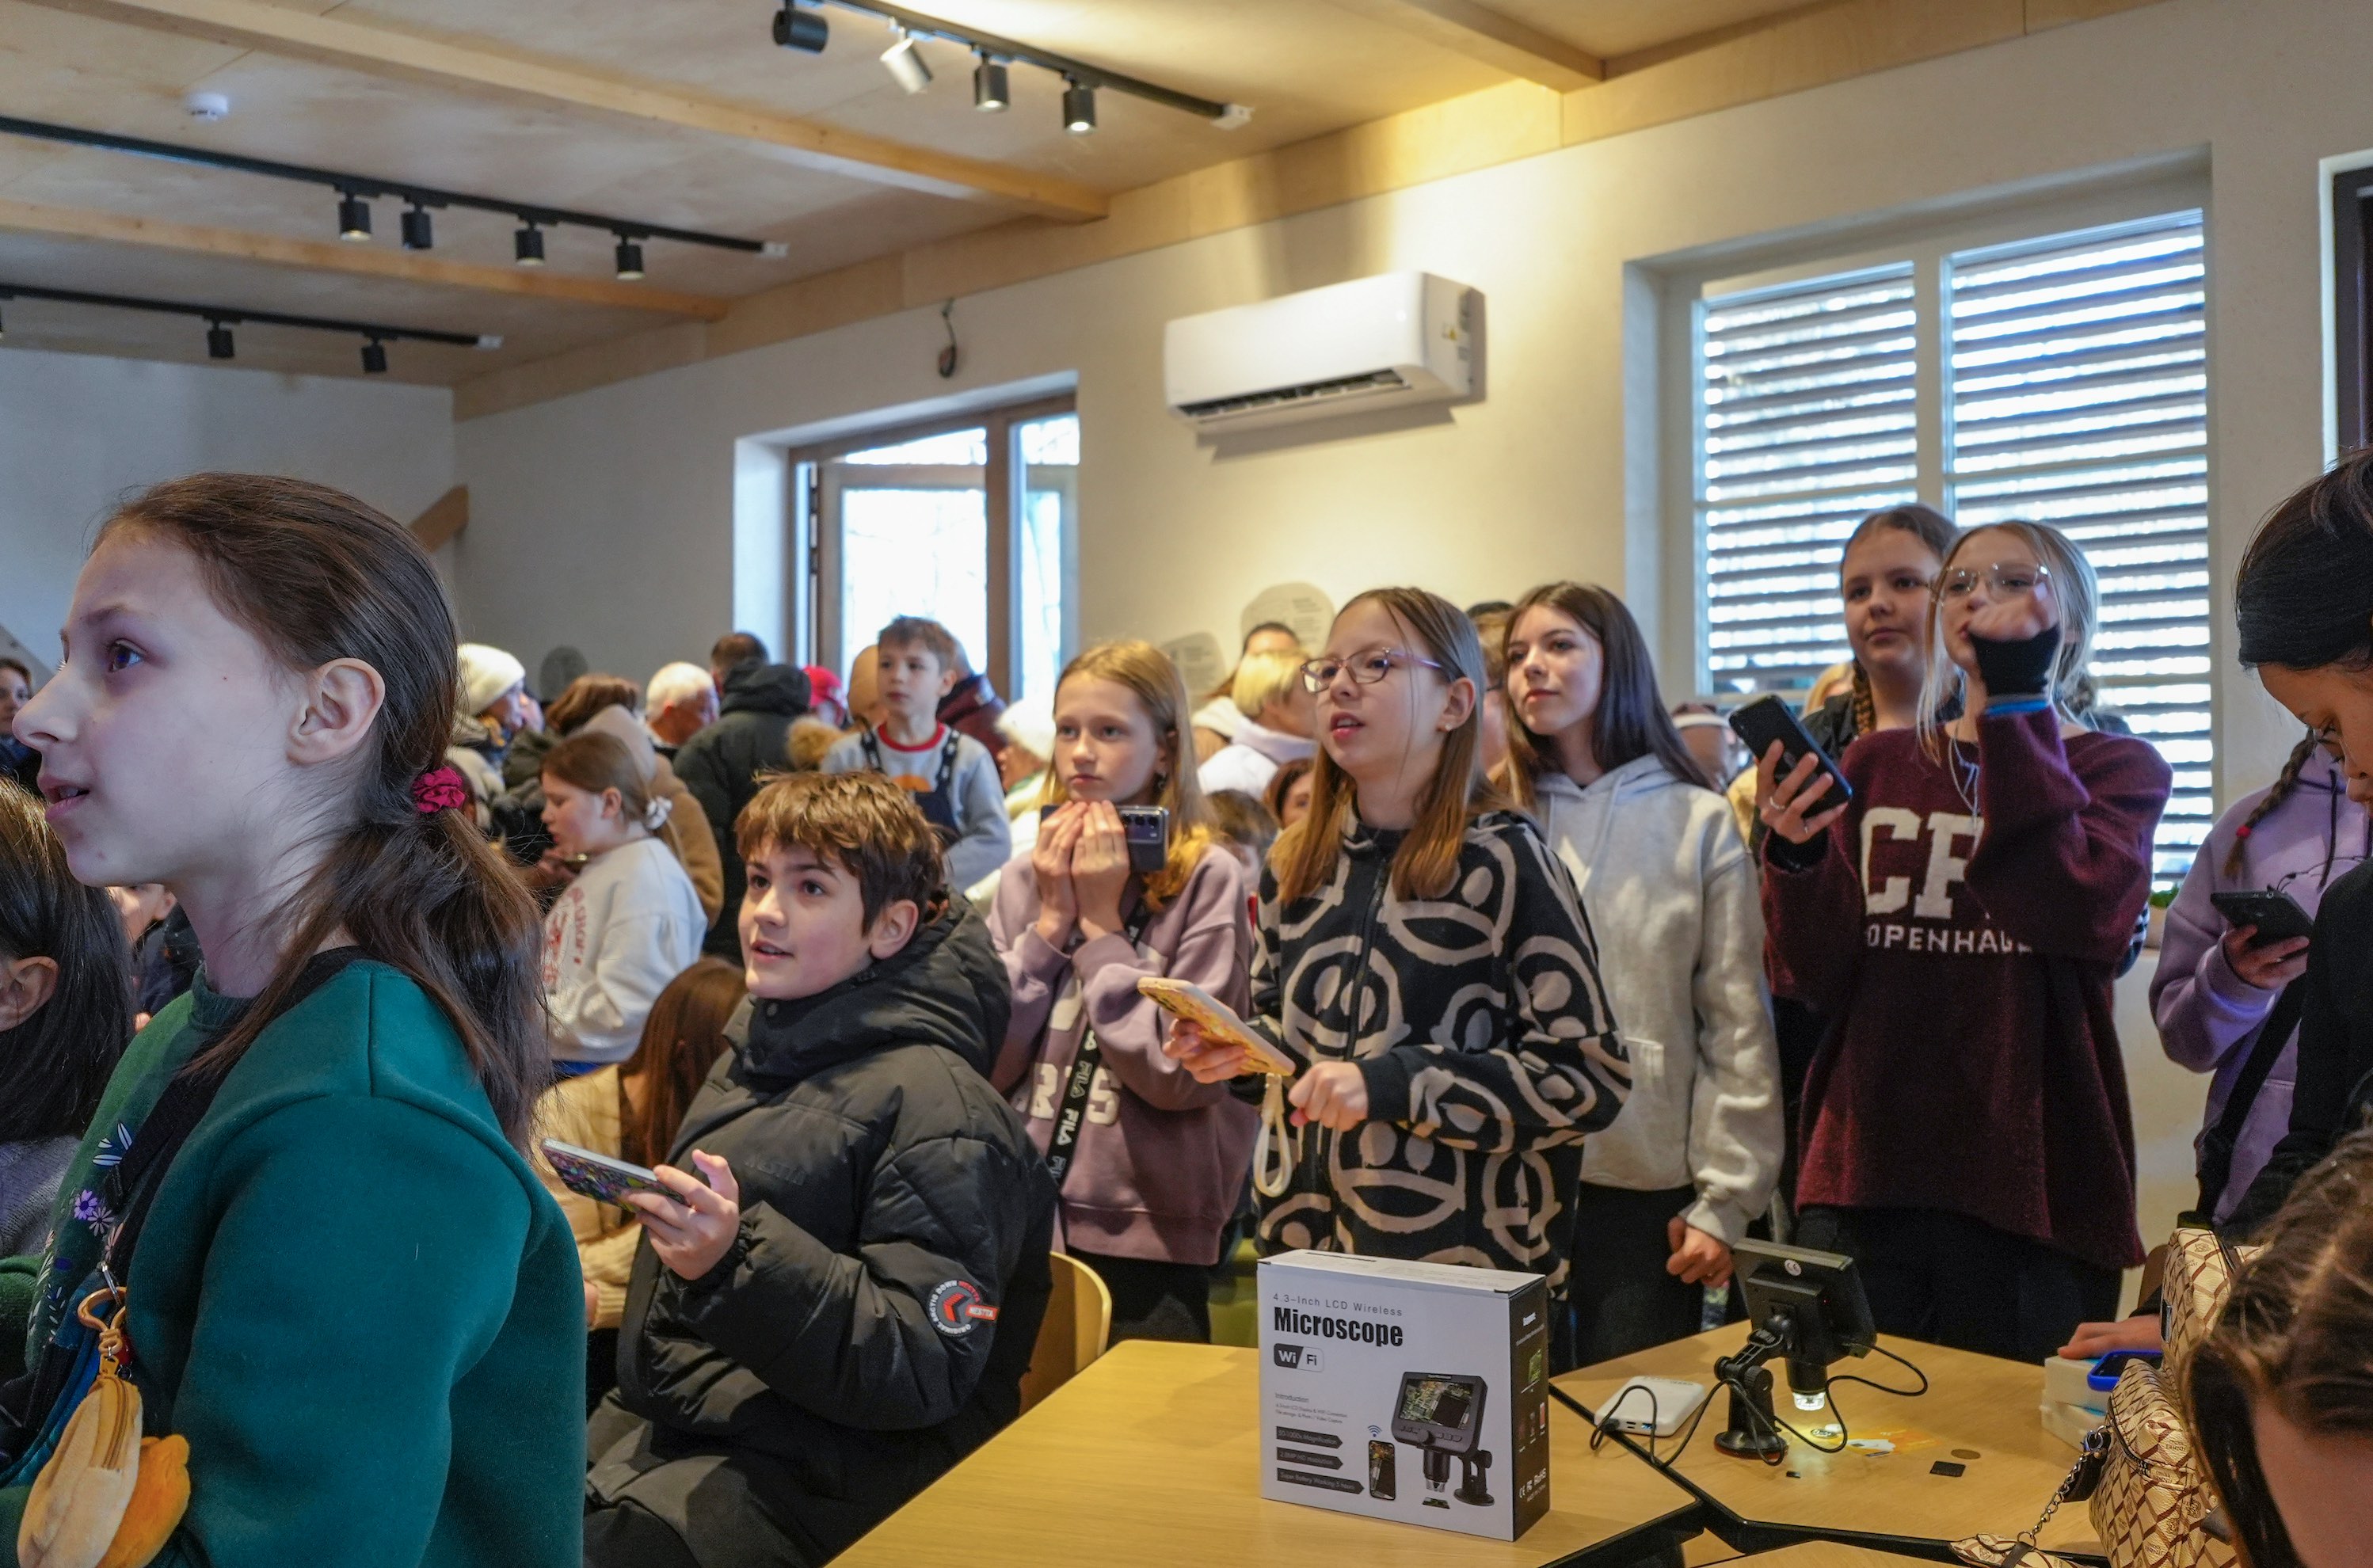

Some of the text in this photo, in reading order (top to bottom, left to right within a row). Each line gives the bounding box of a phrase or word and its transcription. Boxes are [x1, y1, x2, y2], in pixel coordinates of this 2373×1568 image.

[1070, 1060, 1093, 1098] FILA
[1057, 1108, 1079, 1146] FILA
[1274, 1307, 1404, 1347] Microscope
[1325, 1300, 1348, 1310] LCD
[1353, 1302, 1403, 1316] Wireless
